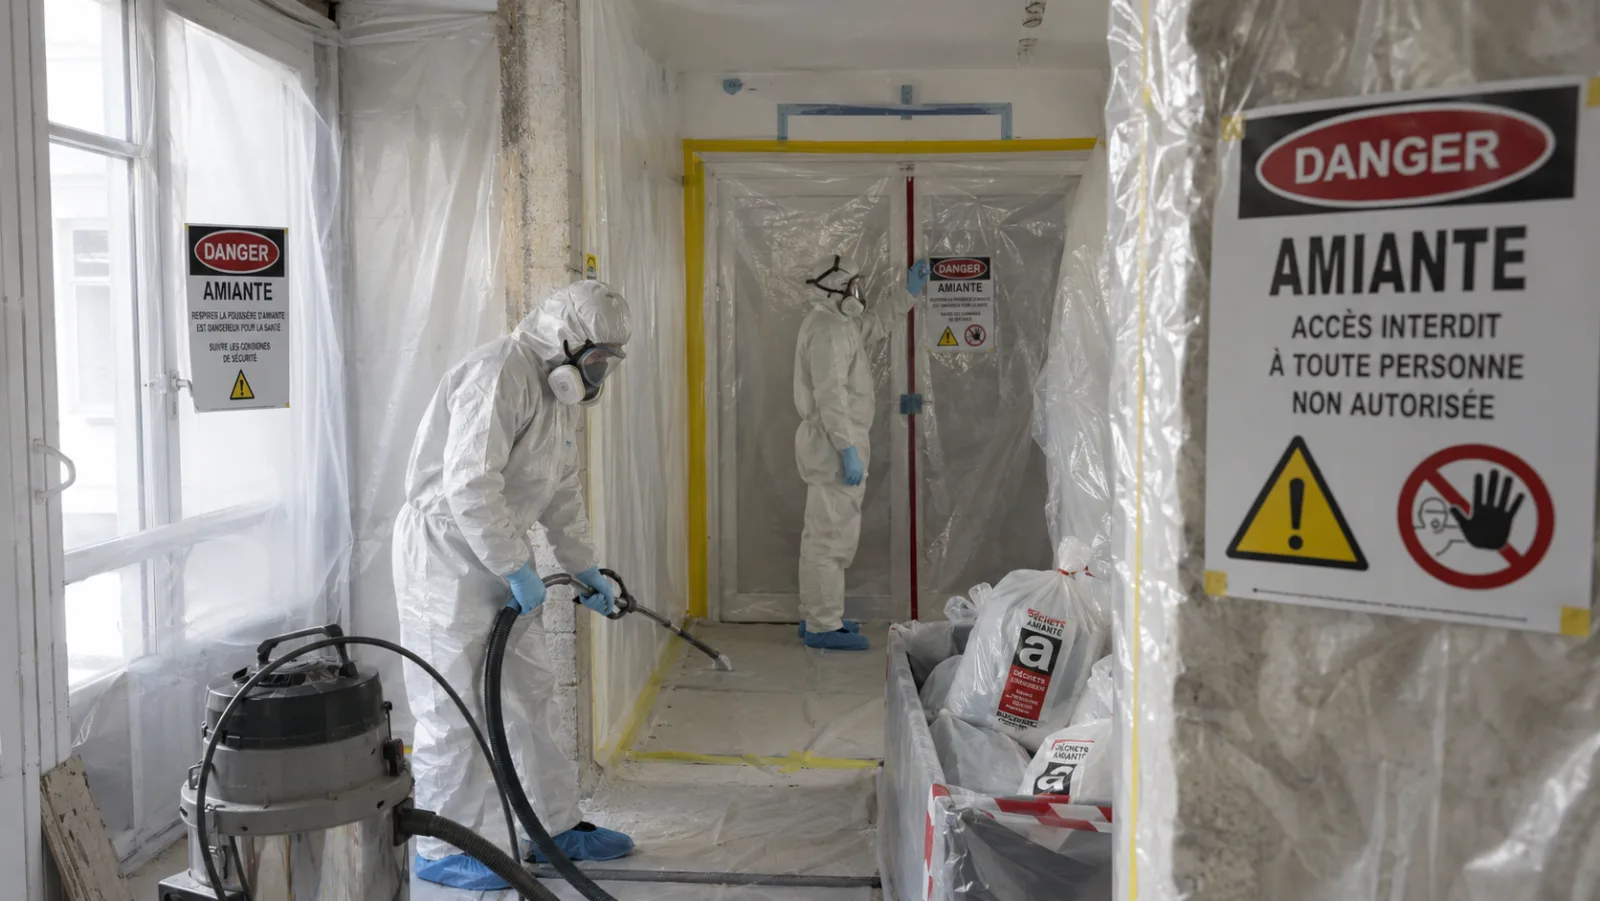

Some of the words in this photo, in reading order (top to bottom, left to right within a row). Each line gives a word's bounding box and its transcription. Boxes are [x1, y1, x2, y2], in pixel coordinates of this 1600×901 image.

[1294, 129, 1500, 185] DANGER
[204, 242, 269, 262] DANGER
[1269, 225, 1528, 297] AMIANTE
[938, 264, 981, 274] DANGER
[203, 281, 273, 301] AMIANTE
[937, 282, 983, 293] AMIANTE
[1291, 308, 1373, 339] ACCÈS
[1381, 312, 1502, 339] INTERDIT
[229, 342, 240, 351] LES
[223, 354, 230, 362] DE
[1268, 347, 1285, 377] À
[1293, 353, 1371, 378] TOUTE
[1380, 354, 1524, 380] PERSONNE
[1292, 391, 1341, 415] NON
[1350, 388, 1495, 420] AUTORISÉE
[1026, 620, 1063, 637] AMIANTE
[1019, 635, 1054, 672] a
